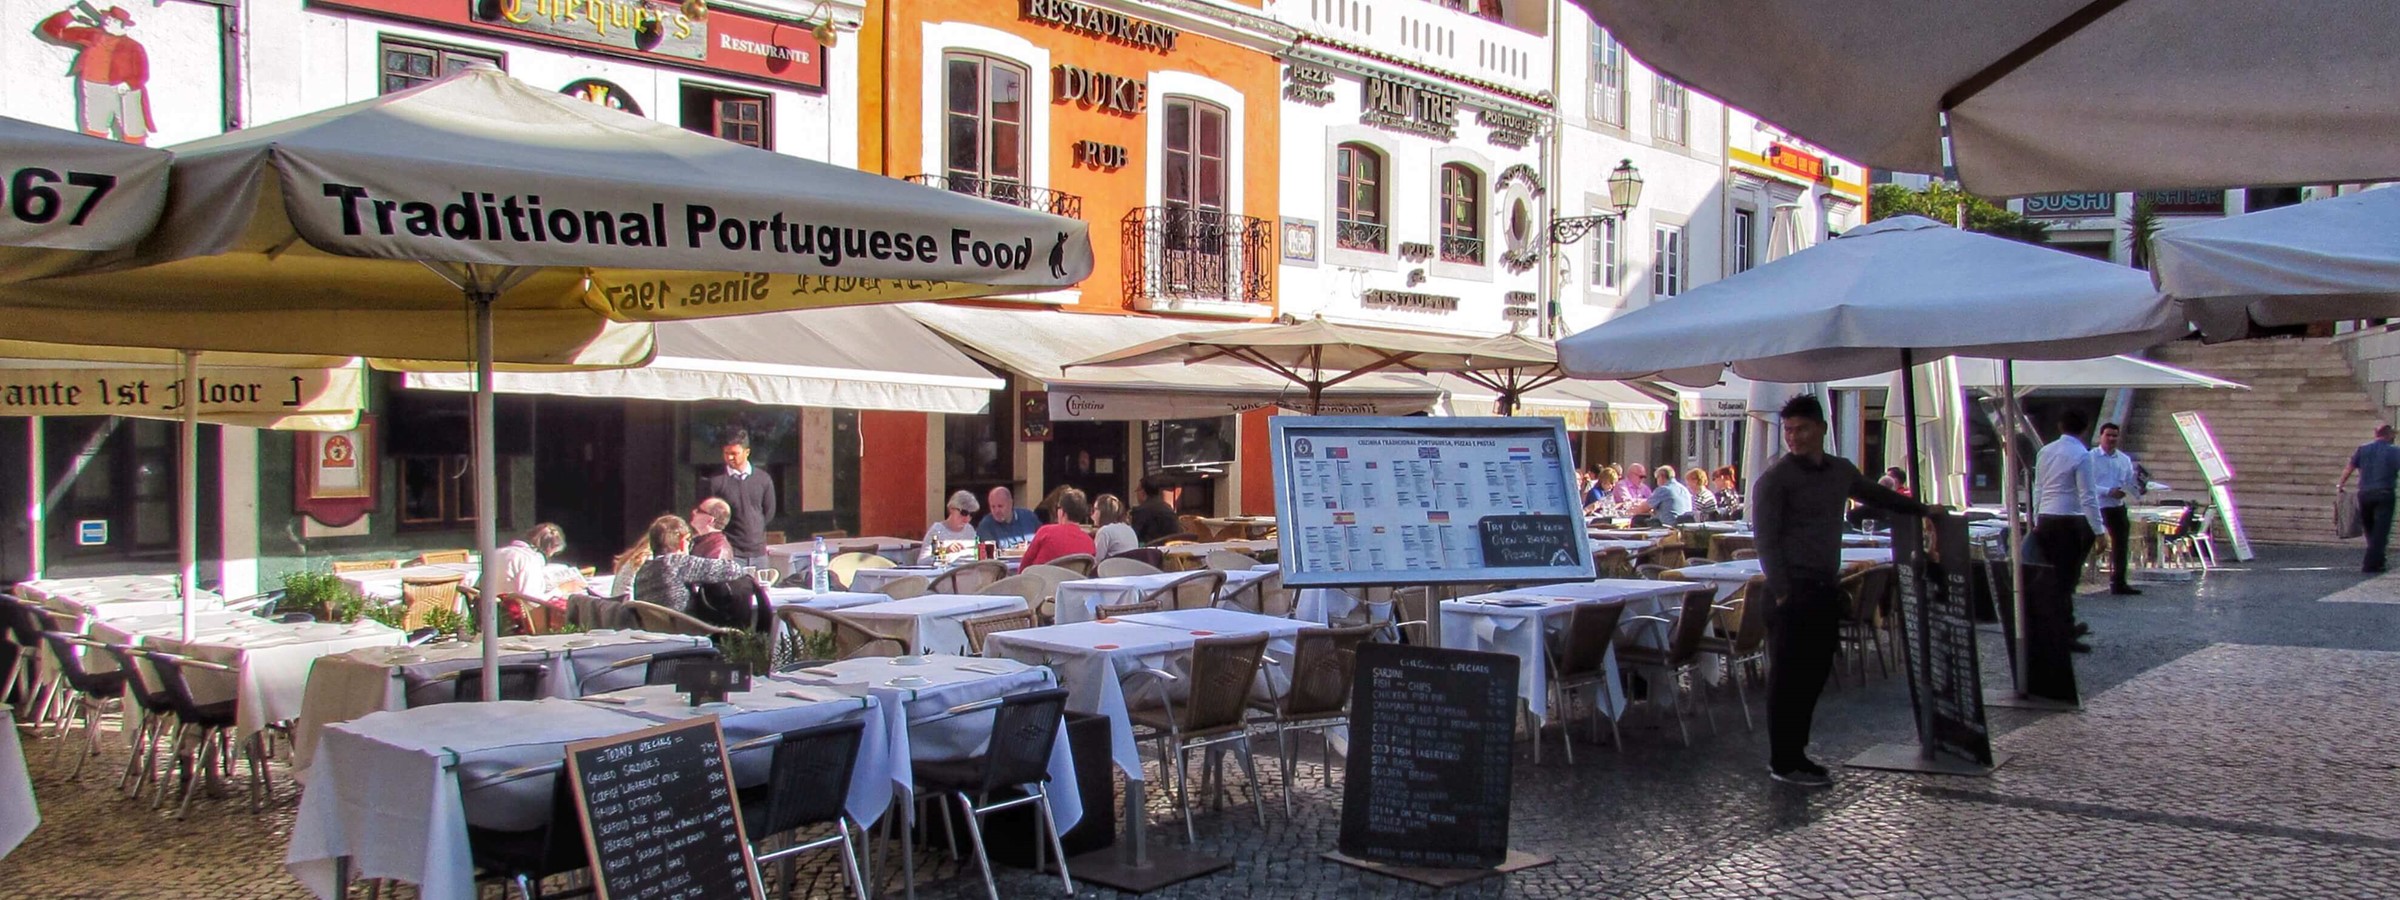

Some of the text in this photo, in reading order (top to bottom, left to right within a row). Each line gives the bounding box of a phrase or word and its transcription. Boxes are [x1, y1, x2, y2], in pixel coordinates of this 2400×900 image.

[1029, 0, 1179, 52] RESTAURANT
[1292, 62, 1335, 83] PIZZAS
[1060, 63, 1148, 114] DUKE
[1292, 83, 1335, 102] PASTAS
[1367, 77, 1460, 127] PALM TREE
[1083, 140, 1129, 169] PUB
[0, 167, 119, 227] 67
[2027, 192, 2110, 212] SUSHI
[323, 182, 1033, 271] Traditional Portuguese Food
[0, 378, 82, 406] ante
[97, 378, 150, 406] 1st
[1066, 394, 1105, 416] Christina
[1373, 679, 1391, 689] FISH
